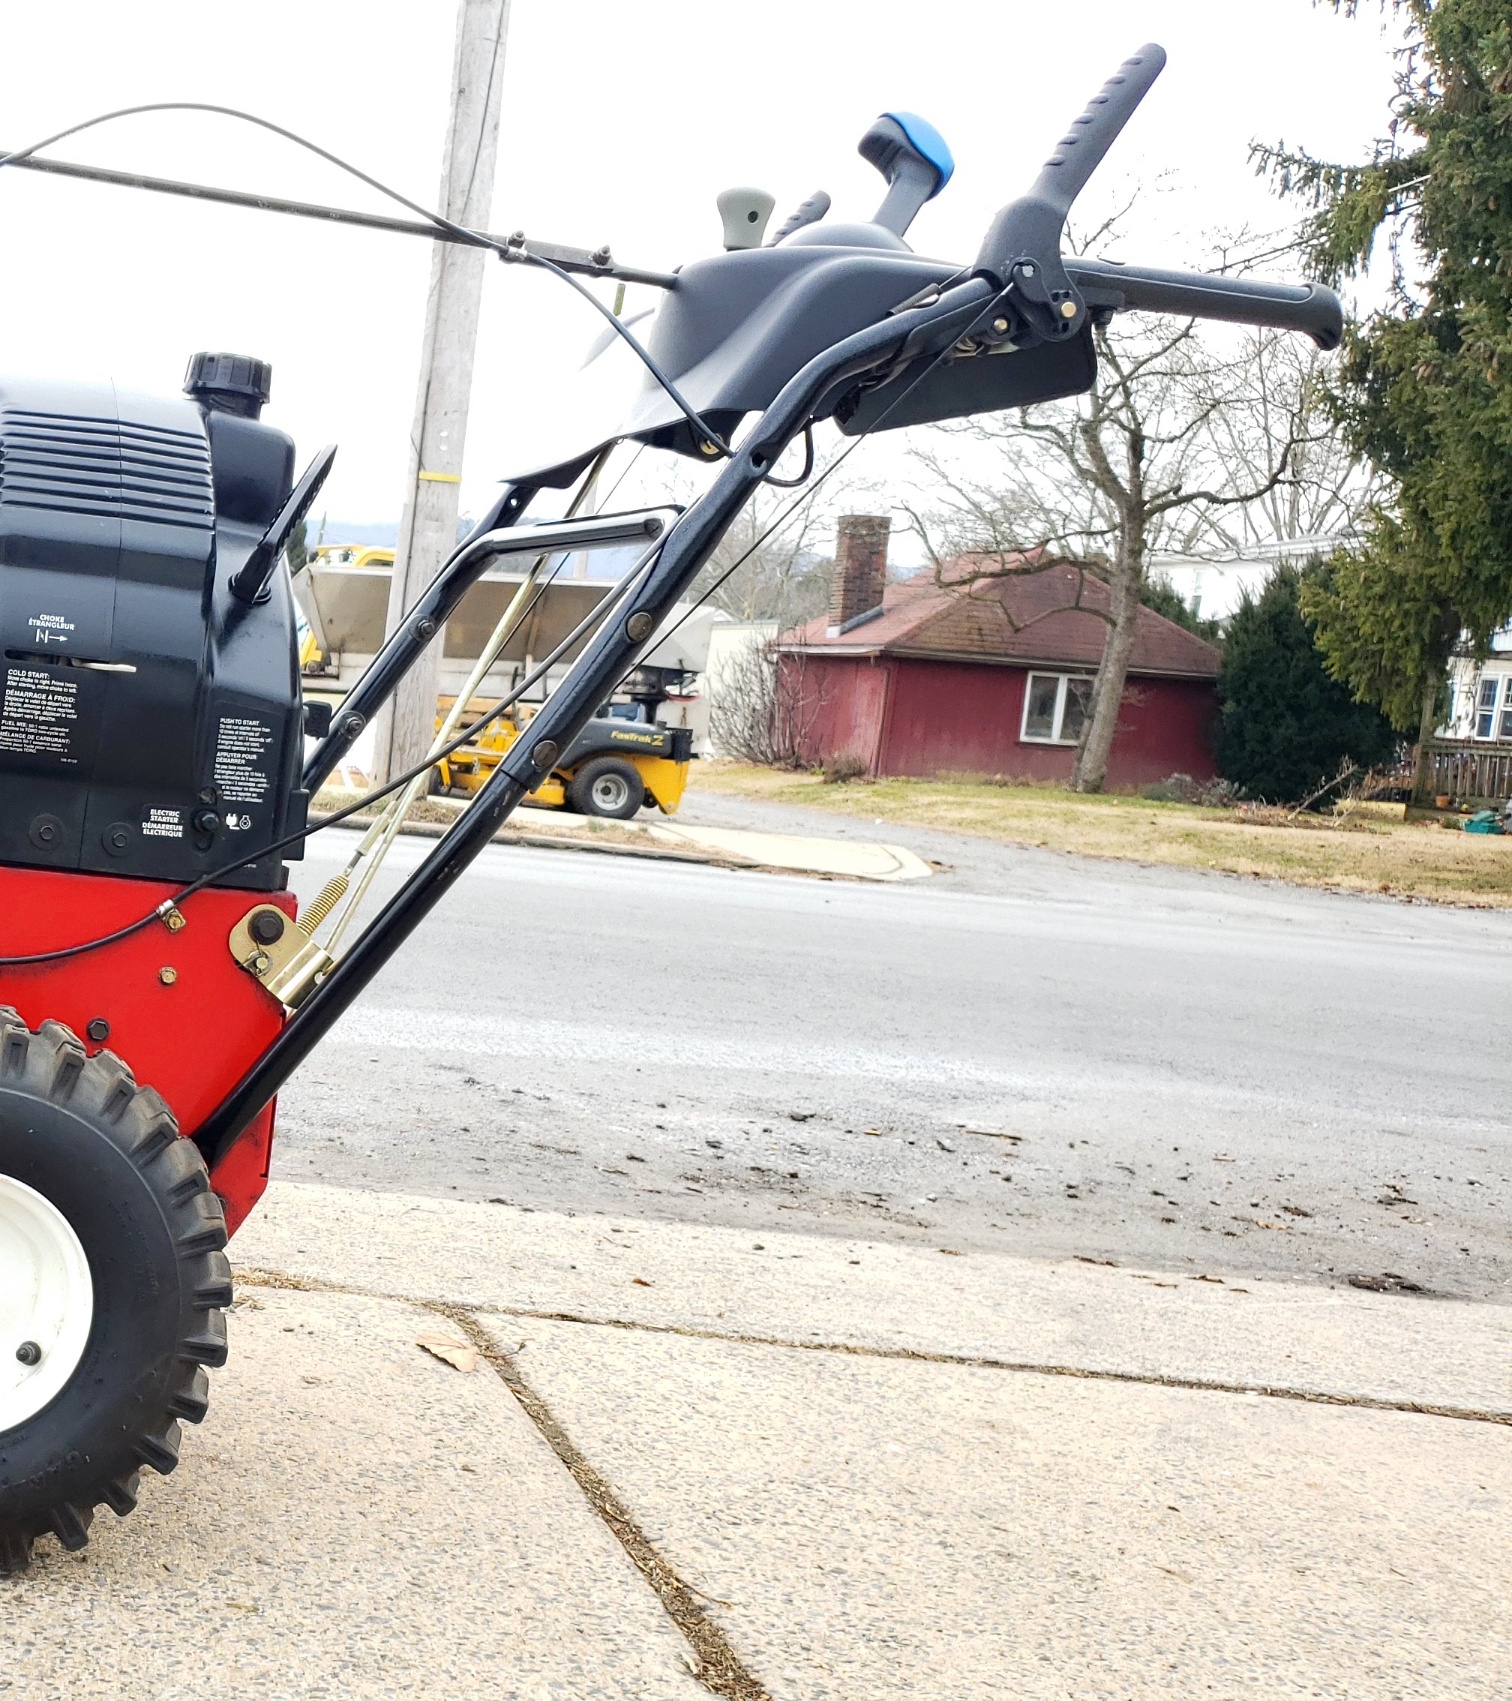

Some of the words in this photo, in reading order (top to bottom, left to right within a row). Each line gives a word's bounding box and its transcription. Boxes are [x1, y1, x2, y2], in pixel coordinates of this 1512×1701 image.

[28, 617, 75, 631] ÉTRANGLEUR
[39, 614, 65, 624] CHOKE
[150, 809, 180, 818] ELECTRIC
[150, 816, 179, 824] STARTER
[142, 821, 183, 832] DÉMARREUR
